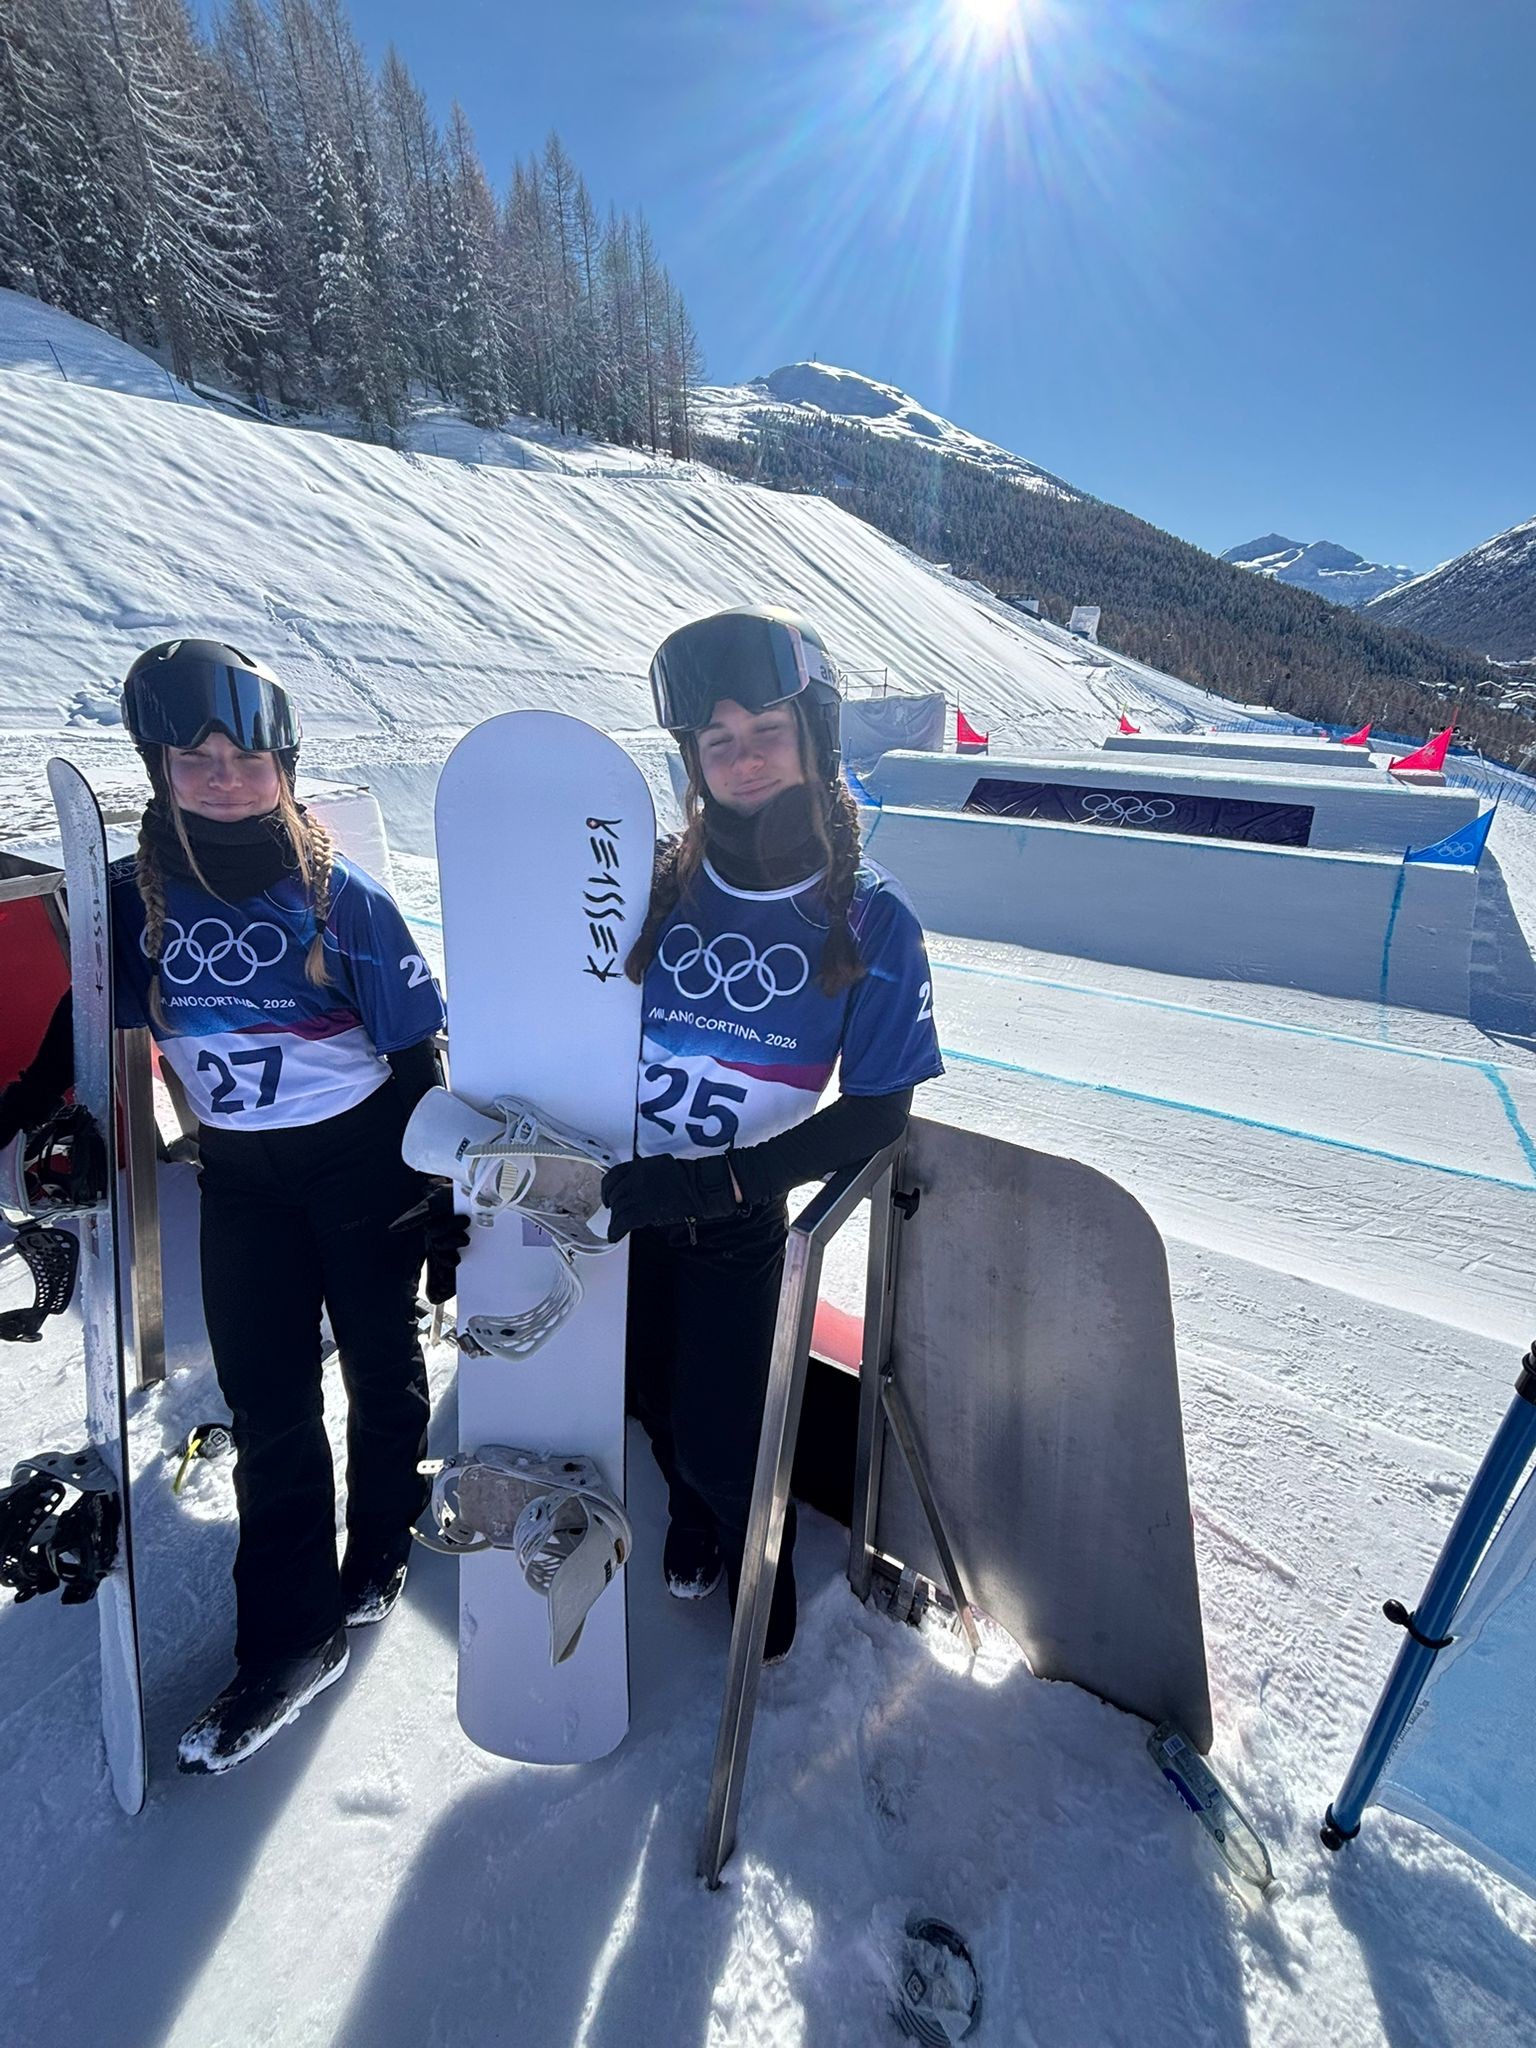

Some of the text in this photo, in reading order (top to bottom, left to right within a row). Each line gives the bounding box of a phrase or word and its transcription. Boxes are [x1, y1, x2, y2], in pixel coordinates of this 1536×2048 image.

[582, 816, 627, 984] KESSLER
[262, 999, 296, 1009] 2026
[764, 1033, 797, 1050] 2026
[196, 1045, 283, 1115] 27
[639, 1063, 749, 1148] 25
